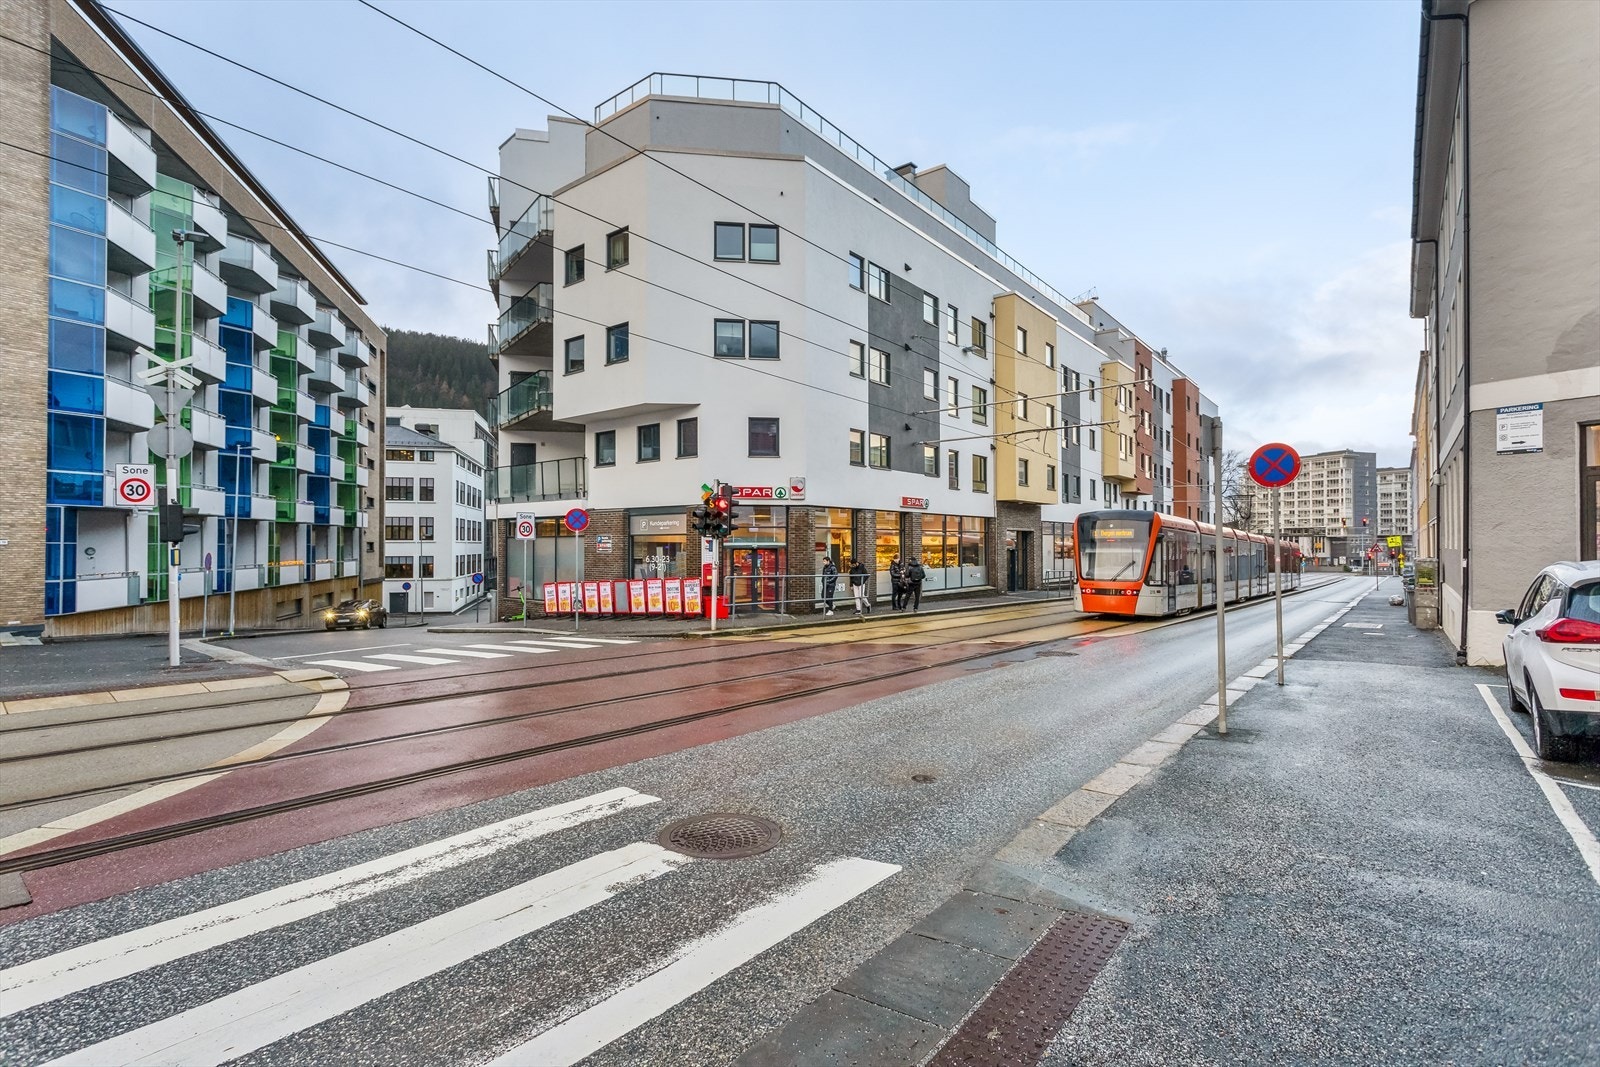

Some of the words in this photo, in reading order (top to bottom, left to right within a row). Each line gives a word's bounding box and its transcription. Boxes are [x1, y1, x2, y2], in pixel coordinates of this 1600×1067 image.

[1500, 405, 1539, 413] PARKERING
[122, 466, 148, 474] Sone
[126, 484, 145, 496] 30
[521, 525, 530, 533] 30
[645, 555, 670, 563] 6.30-23
[649, 563, 667, 572] (9-21)
